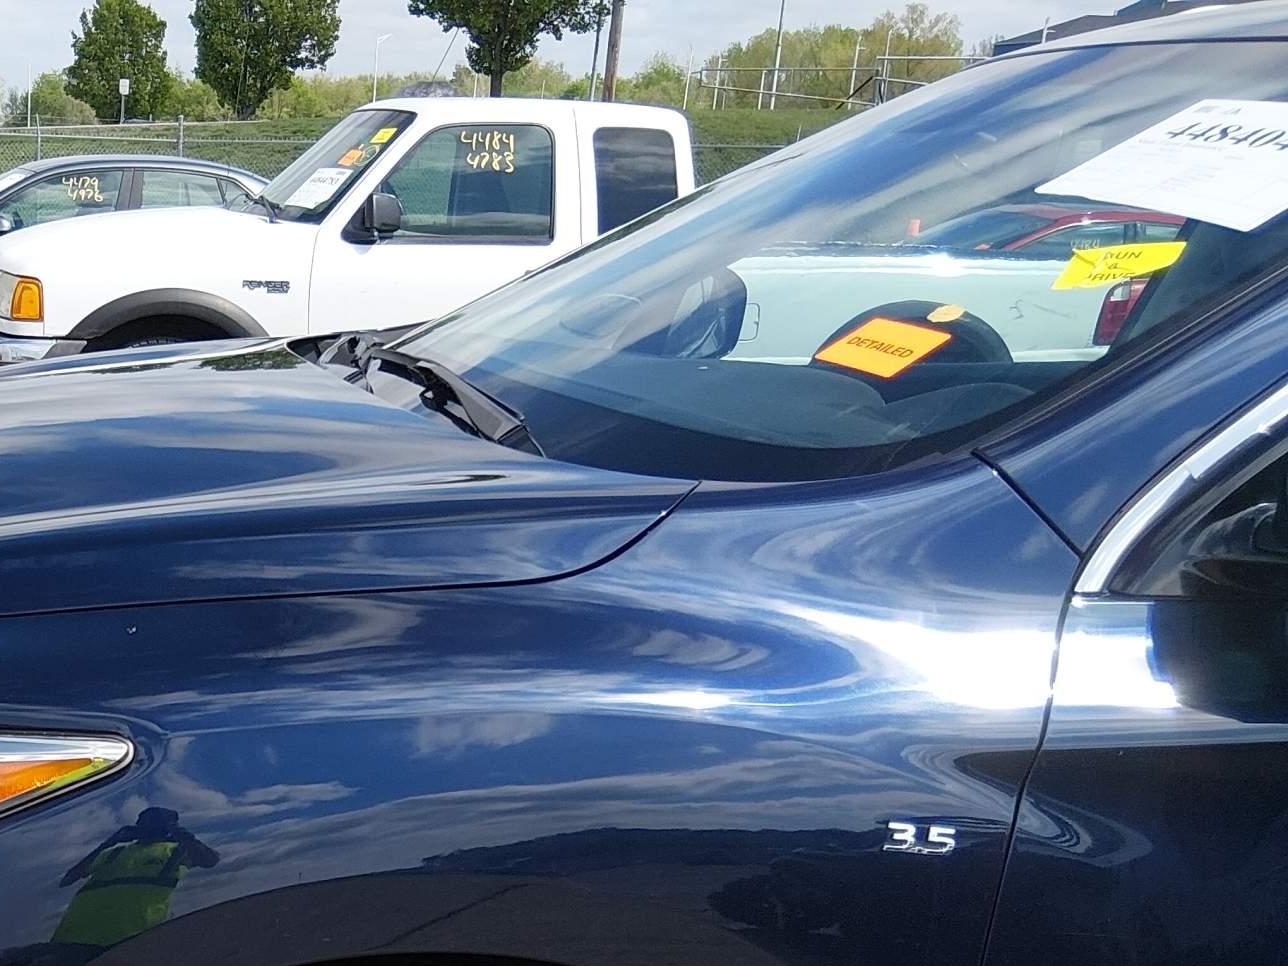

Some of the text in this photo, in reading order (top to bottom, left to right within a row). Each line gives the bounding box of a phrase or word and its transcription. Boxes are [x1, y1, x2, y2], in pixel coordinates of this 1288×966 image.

[460, 130, 515, 152] 4484
[466, 151, 515, 173] 4783
[62, 176, 99, 191] 4479
[67, 187, 104, 202] 4976
[1088, 271, 1137, 281] RIVE
[846, 335, 915, 359] DETAILED
